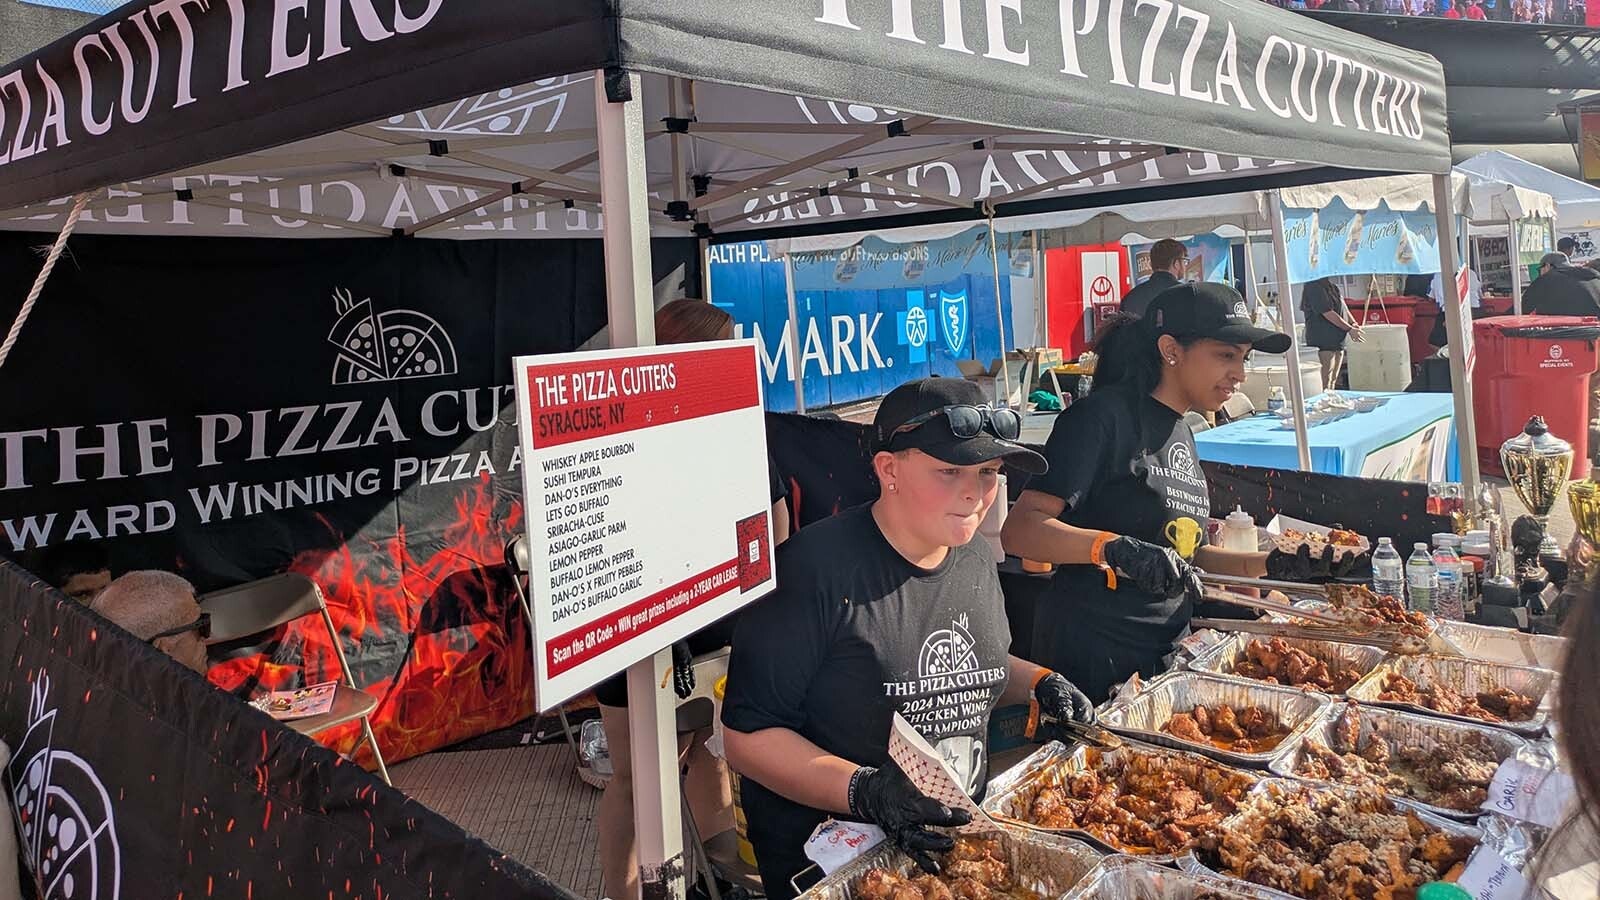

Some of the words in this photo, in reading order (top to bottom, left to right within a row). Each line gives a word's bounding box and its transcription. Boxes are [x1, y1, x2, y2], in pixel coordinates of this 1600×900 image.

[1060, 0, 1256, 111] PIZZA
[1255, 35, 1427, 141] CUTTERS
[734, 312, 884, 384] MARK
[535, 375, 568, 408] THE
[572, 369, 618, 403] PIZZA
[621, 363, 677, 396] CUTTERS
[540, 406, 607, 438] SYRACUSE,
[609, 402, 625, 425] NY
[0, 418, 173, 491] THE
[197, 397, 411, 468] PIZZA
[542, 454, 577, 472] WHISKEY
[579, 449, 600, 464] APPLE
[601, 442, 635, 459] BOURBON
[544, 473, 566, 489] SUSHI
[568, 465, 602, 483] TEMPURA
[1150, 465, 1170, 477] THE
[1, 500, 177, 551] WARD
[188, 467, 380, 524] WINNING
[394, 445, 496, 490] PIZZA
[545, 486, 579, 506] DAN-O'S
[580, 475, 623, 496] EVERYTHING
[546, 507, 563, 522] LETS
[564, 503, 577, 517] GO
[579, 494, 610, 513] BUFFALO
[547, 511, 605, 539] SRIRACHA-CUSE
[549, 526, 607, 556] ASIAGO-GARLIC
[608, 520, 627, 536] PARM
[550, 553, 577, 572] LEMON
[579, 543, 604, 562] PEPPER
[550, 567, 583, 589] BUFFALO
[585, 557, 610, 576] LEMON
[611, 548, 635, 566] PEPPER
[552, 582, 585, 606] DAN-O'S
[586, 580, 593, 592] X
[593, 570, 617, 589] FRUITY
[618, 560, 643, 579] PEBBLES
[553, 598, 586, 622] DAN-O'S
[587, 586, 618, 608] BUFFALO
[619, 576, 642, 594] GARLIC
[552, 645, 572, 664] Scan
[572, 638, 585, 655] the
[585, 630, 596, 649] QR
[596, 624, 613, 643] Code
[618, 614, 631, 633] WIN
[632, 607, 648, 630] great
[648, 602, 666, 623] prizes
[665, 590, 690, 611] including
[693, 581, 712, 597] 2-YEAR
[712, 572, 723, 588] CAR
[723, 566, 738, 584] LEASE
[883, 682, 916, 696] THE
[920, 676, 957, 692] PIZZA
[956, 667, 1005, 687] CUTTERS
[902, 697, 933, 714] 2024
[936, 688, 992, 707] NATIONAL
[961, 700, 988, 716] WING
